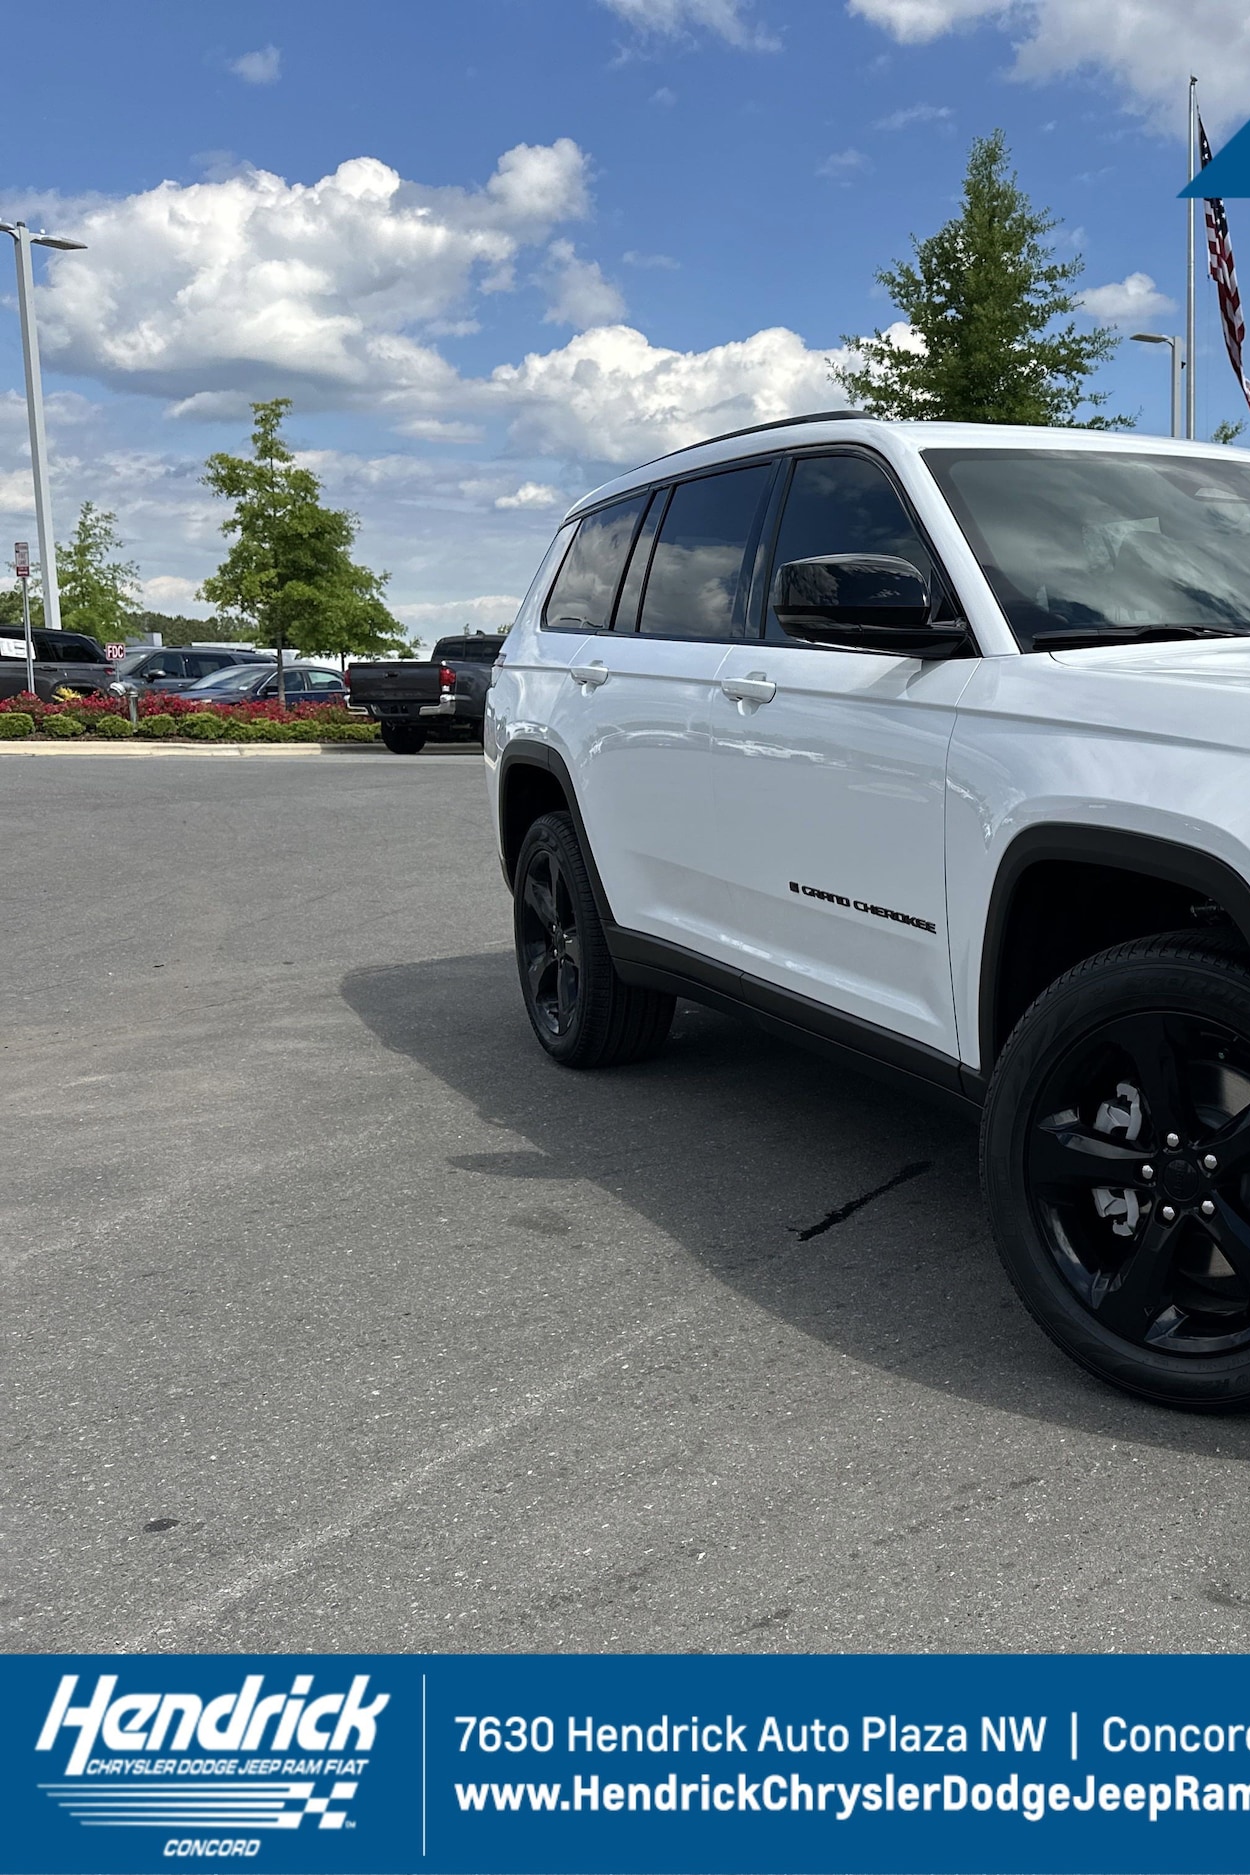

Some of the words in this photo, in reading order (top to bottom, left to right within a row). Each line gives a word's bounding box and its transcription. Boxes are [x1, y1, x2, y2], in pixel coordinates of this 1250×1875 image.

[107, 645, 124, 658] FDC
[801, 886, 851, 908] GRAND
[853, 900, 937, 934] CHEROKEE
